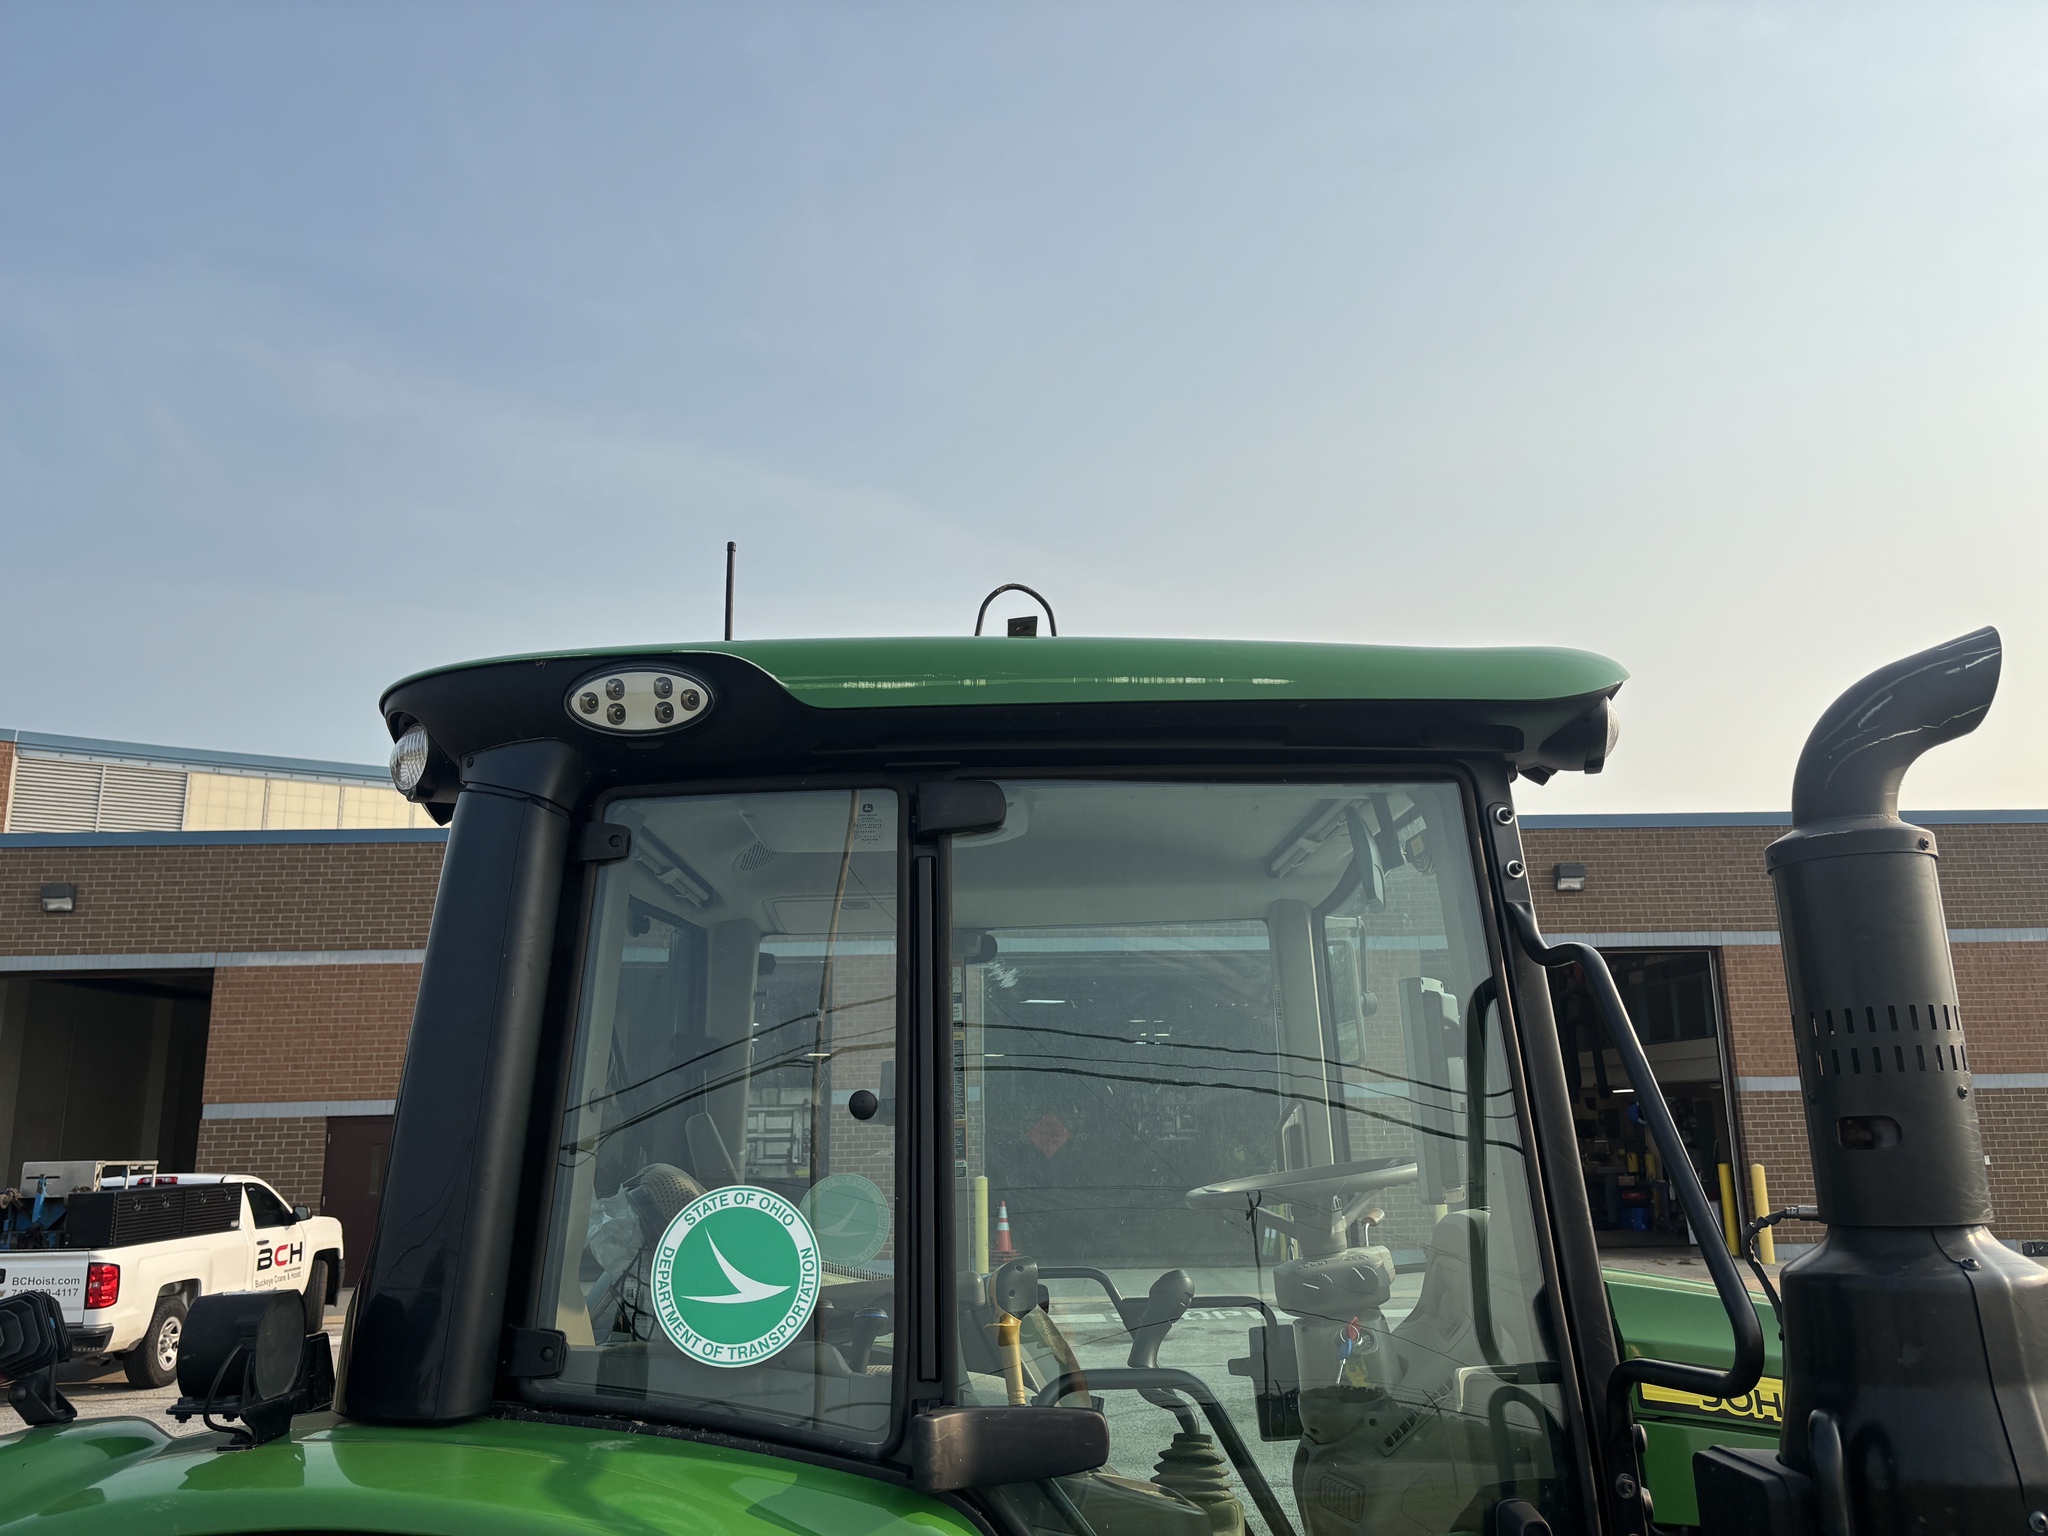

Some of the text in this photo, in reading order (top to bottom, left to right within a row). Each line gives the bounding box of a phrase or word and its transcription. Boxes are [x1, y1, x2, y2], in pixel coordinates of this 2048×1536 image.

[684, 1192, 796, 1227] STATE OF OHIO
[257, 1241, 303, 1272] BCH
[11, 1288, 79, 1297] 740-4117
[12, 1277, 80, 1286] BCHoist.com
[254, 1276, 274, 1288] Buckeye
[274, 1274, 287, 1284] Crane
[657, 1246, 816, 1360] DEPARTMENT OF TRANSPORTATION
[1702, 1389, 1783, 1418] JOH
